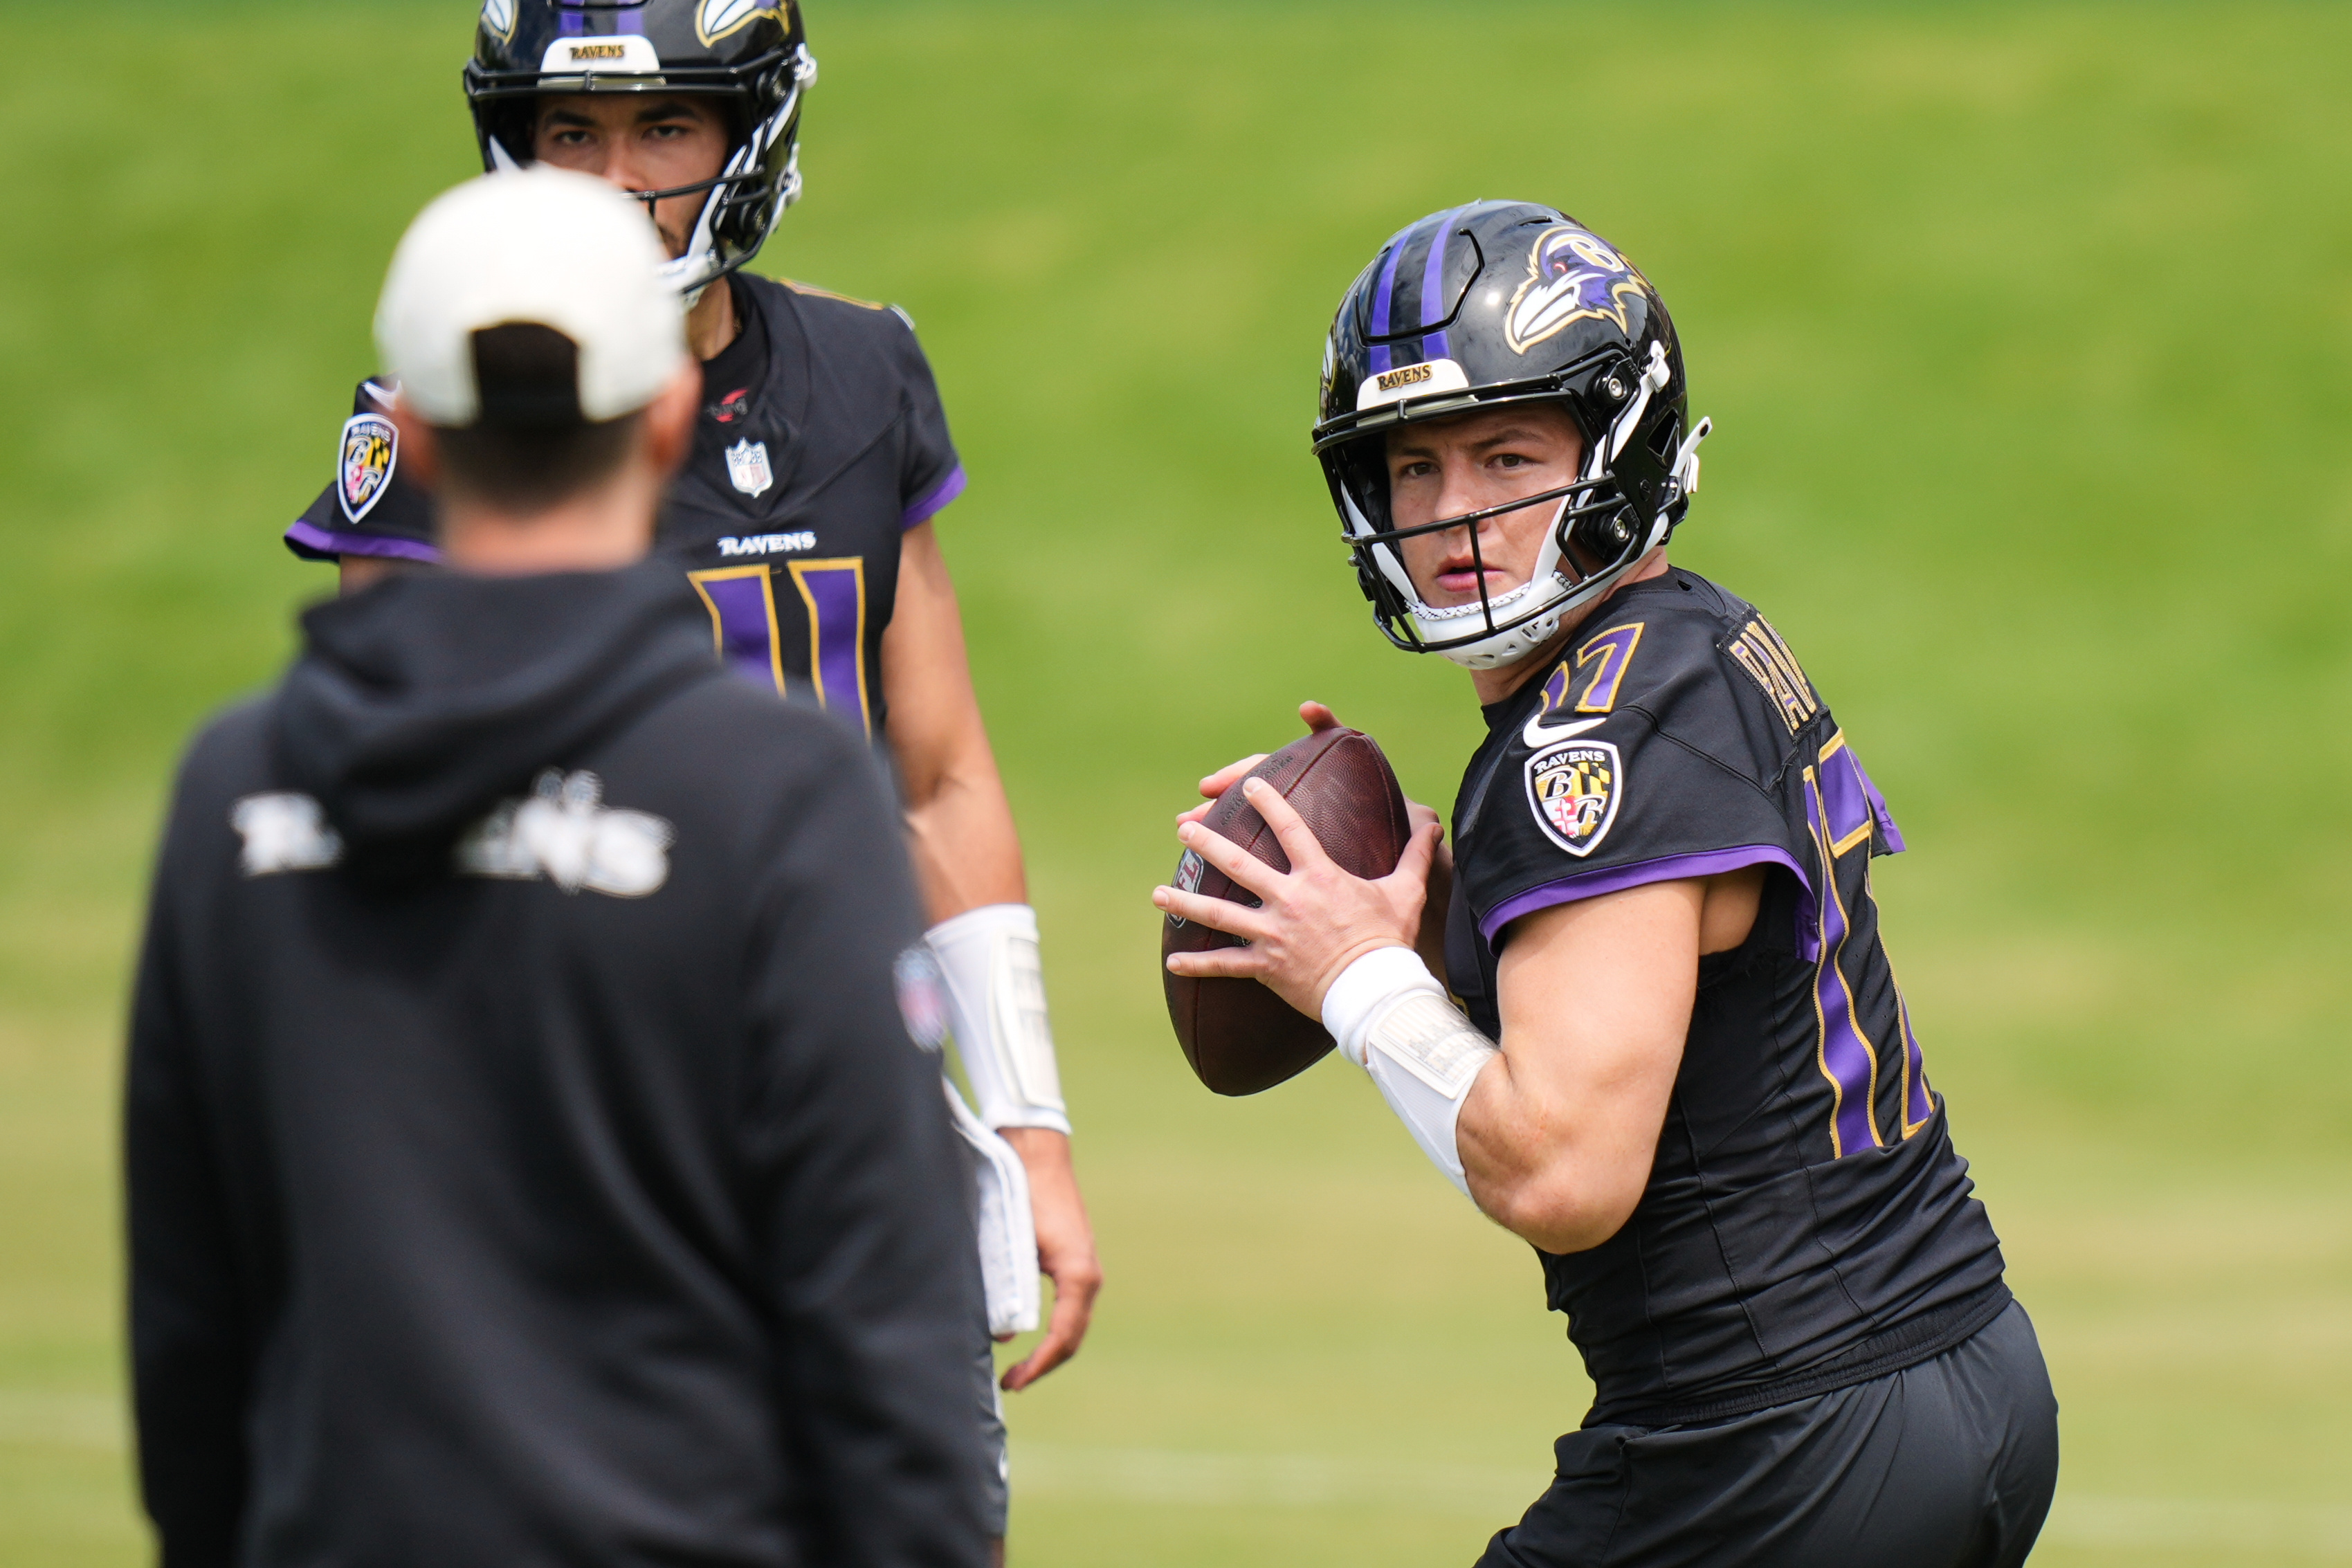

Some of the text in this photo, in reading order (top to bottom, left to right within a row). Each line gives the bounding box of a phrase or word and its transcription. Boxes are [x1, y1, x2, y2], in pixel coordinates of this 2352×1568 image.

[569, 45, 625, 60] RAVENS
[1377, 365, 1433, 392] RAVENS
[717, 530, 817, 556] RAVENS
[1540, 622, 1645, 716] 17
[1533, 750, 1605, 775] RAVENS
